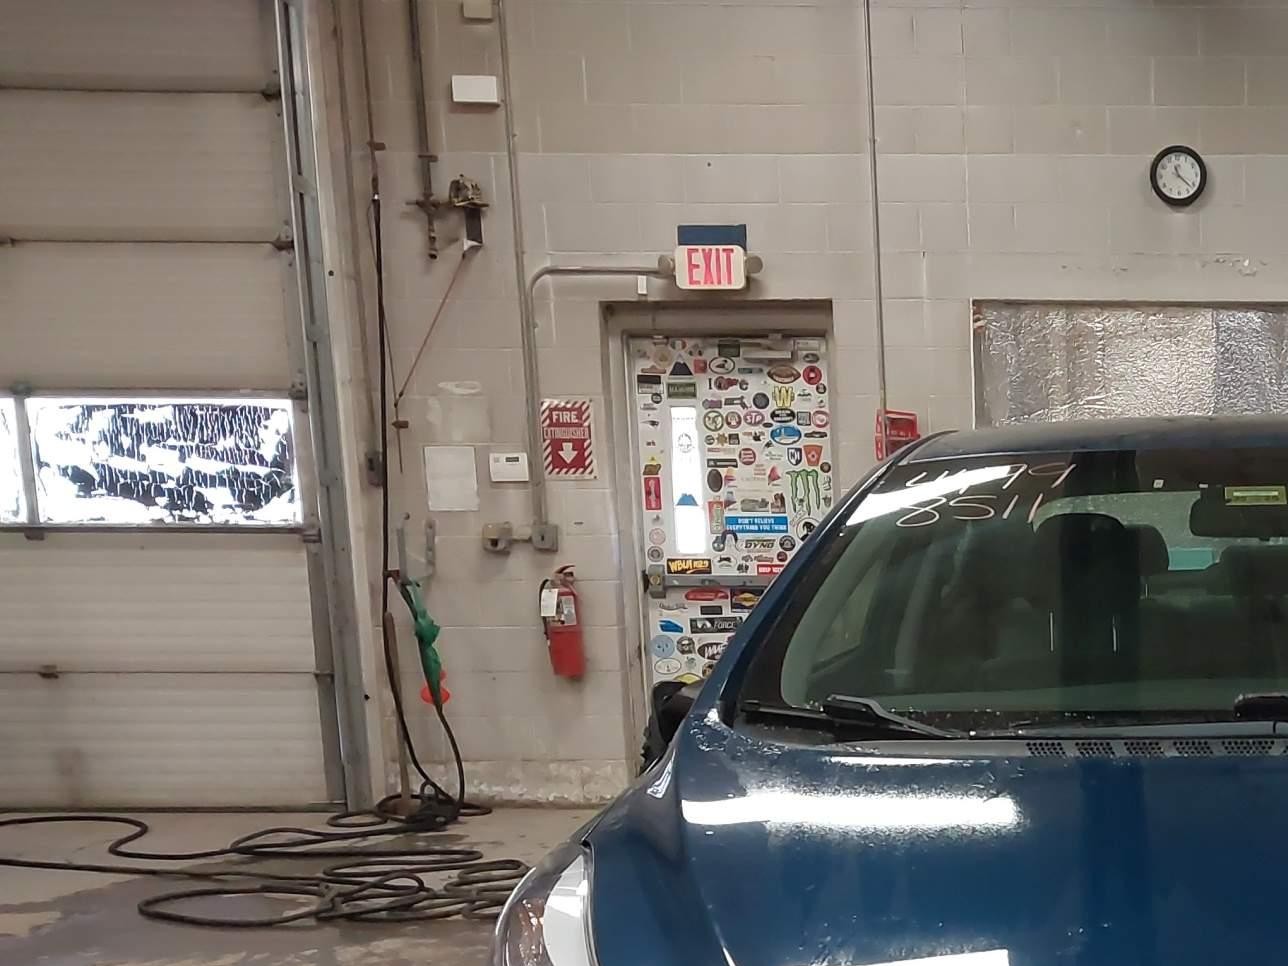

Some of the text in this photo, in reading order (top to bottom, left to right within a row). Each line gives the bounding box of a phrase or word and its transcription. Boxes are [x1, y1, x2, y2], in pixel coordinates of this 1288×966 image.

[687, 248, 734, 285] EXIT
[552, 411, 578, 423] FIRE
[746, 413, 763, 424] STP
[896, 493, 1043, 527] 8511
